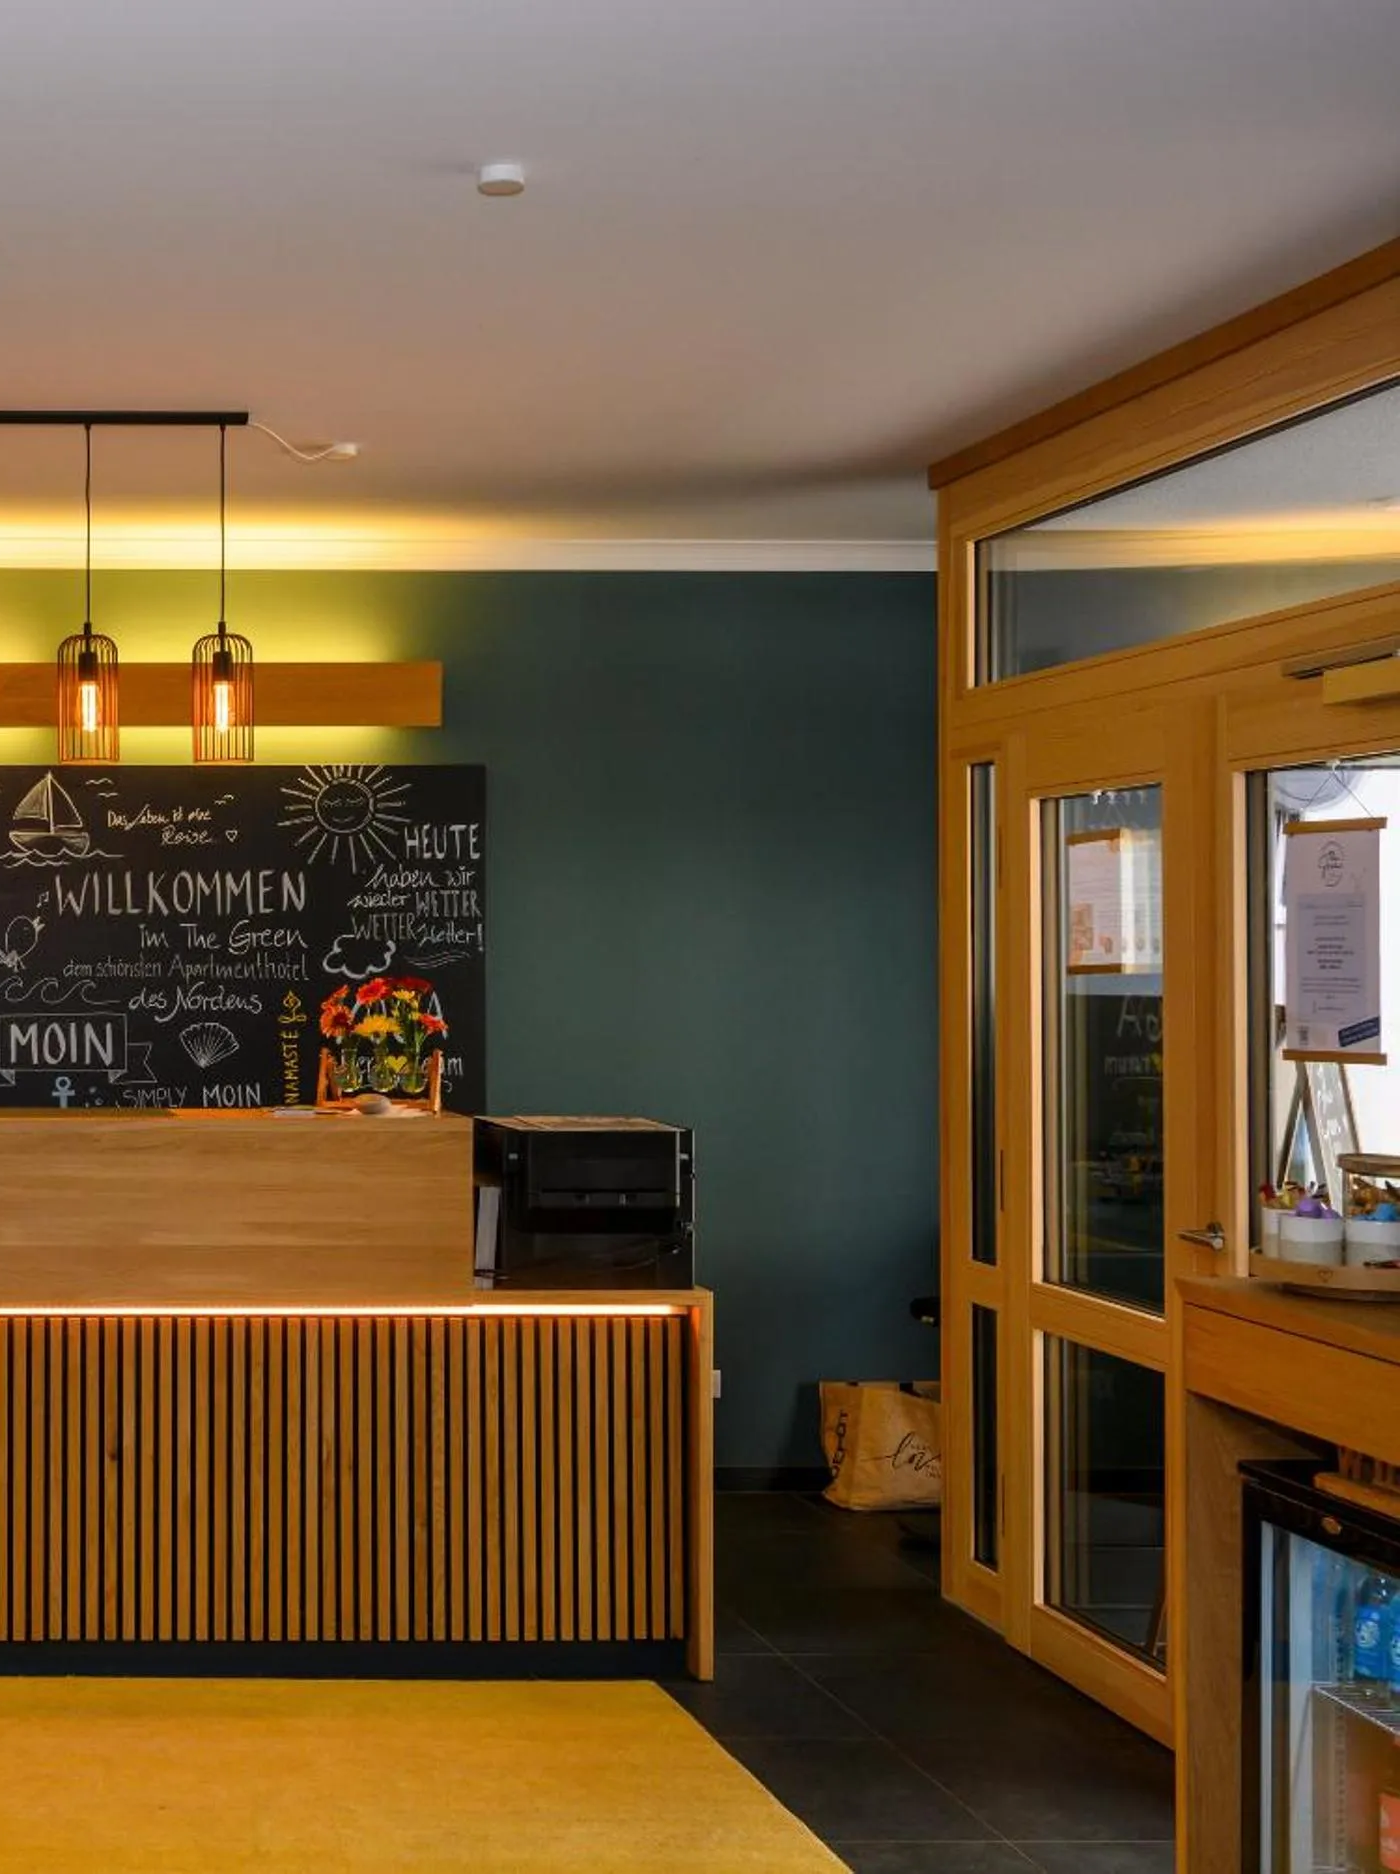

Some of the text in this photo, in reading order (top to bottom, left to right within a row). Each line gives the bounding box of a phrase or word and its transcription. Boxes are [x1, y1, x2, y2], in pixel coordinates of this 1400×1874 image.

[404, 823, 481, 860] HEUTE
[55, 870, 306, 917] WILLKOMMEN
[364, 863, 476, 890] haben wir
[415, 890, 482, 918] WETTER
[179, 923, 220, 949] The
[228, 919, 308, 955] Green
[351, 912, 417, 941] WETTER
[128, 981, 263, 1023] des Nordens
[10, 1022, 113, 1067] MOIN
[280, 1029, 301, 1105] NAMASTE
[122, 1081, 261, 1108] SIMPLY MOIN
